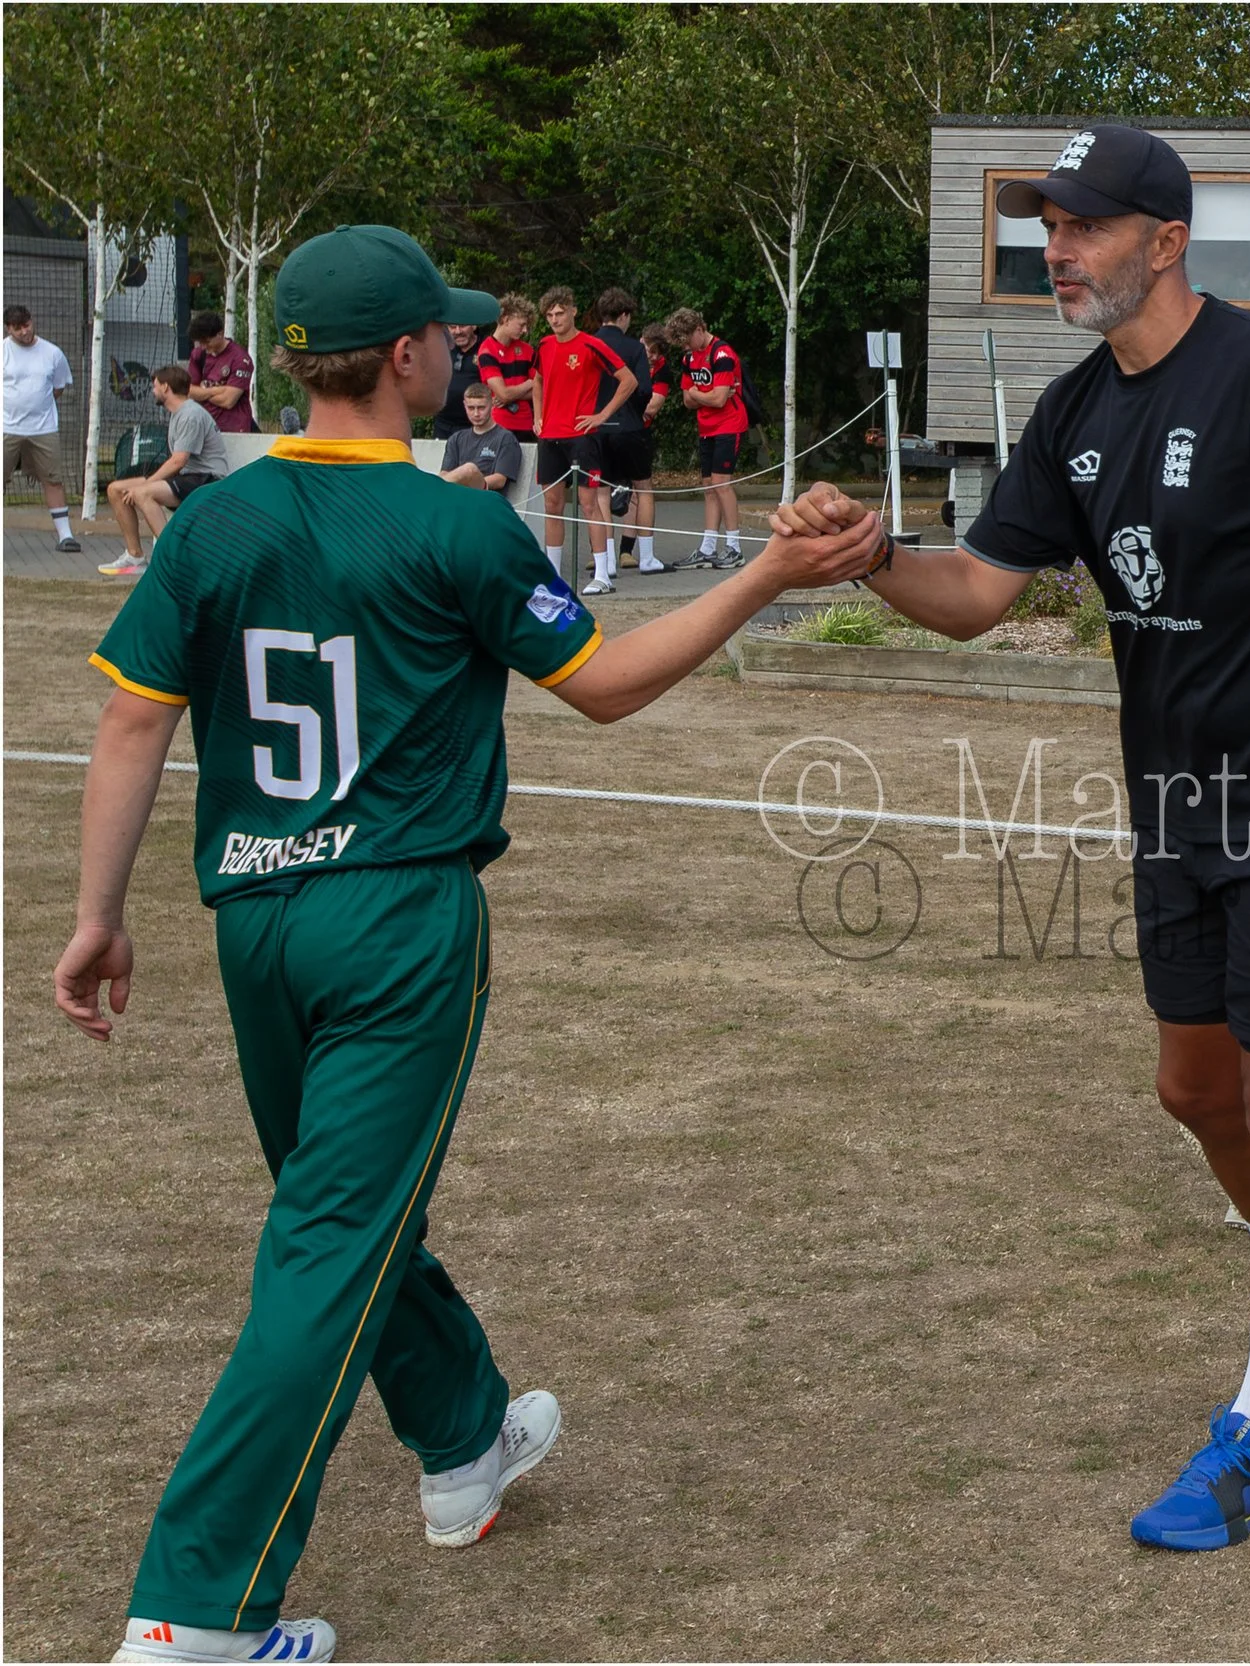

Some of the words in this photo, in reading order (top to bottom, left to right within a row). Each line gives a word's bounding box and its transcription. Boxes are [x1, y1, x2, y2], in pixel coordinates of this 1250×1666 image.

[1168, 427, 1197, 439] GUERNSEY
[243, 628, 360, 800] 51
[217, 824, 357, 874] GUERNSEY
